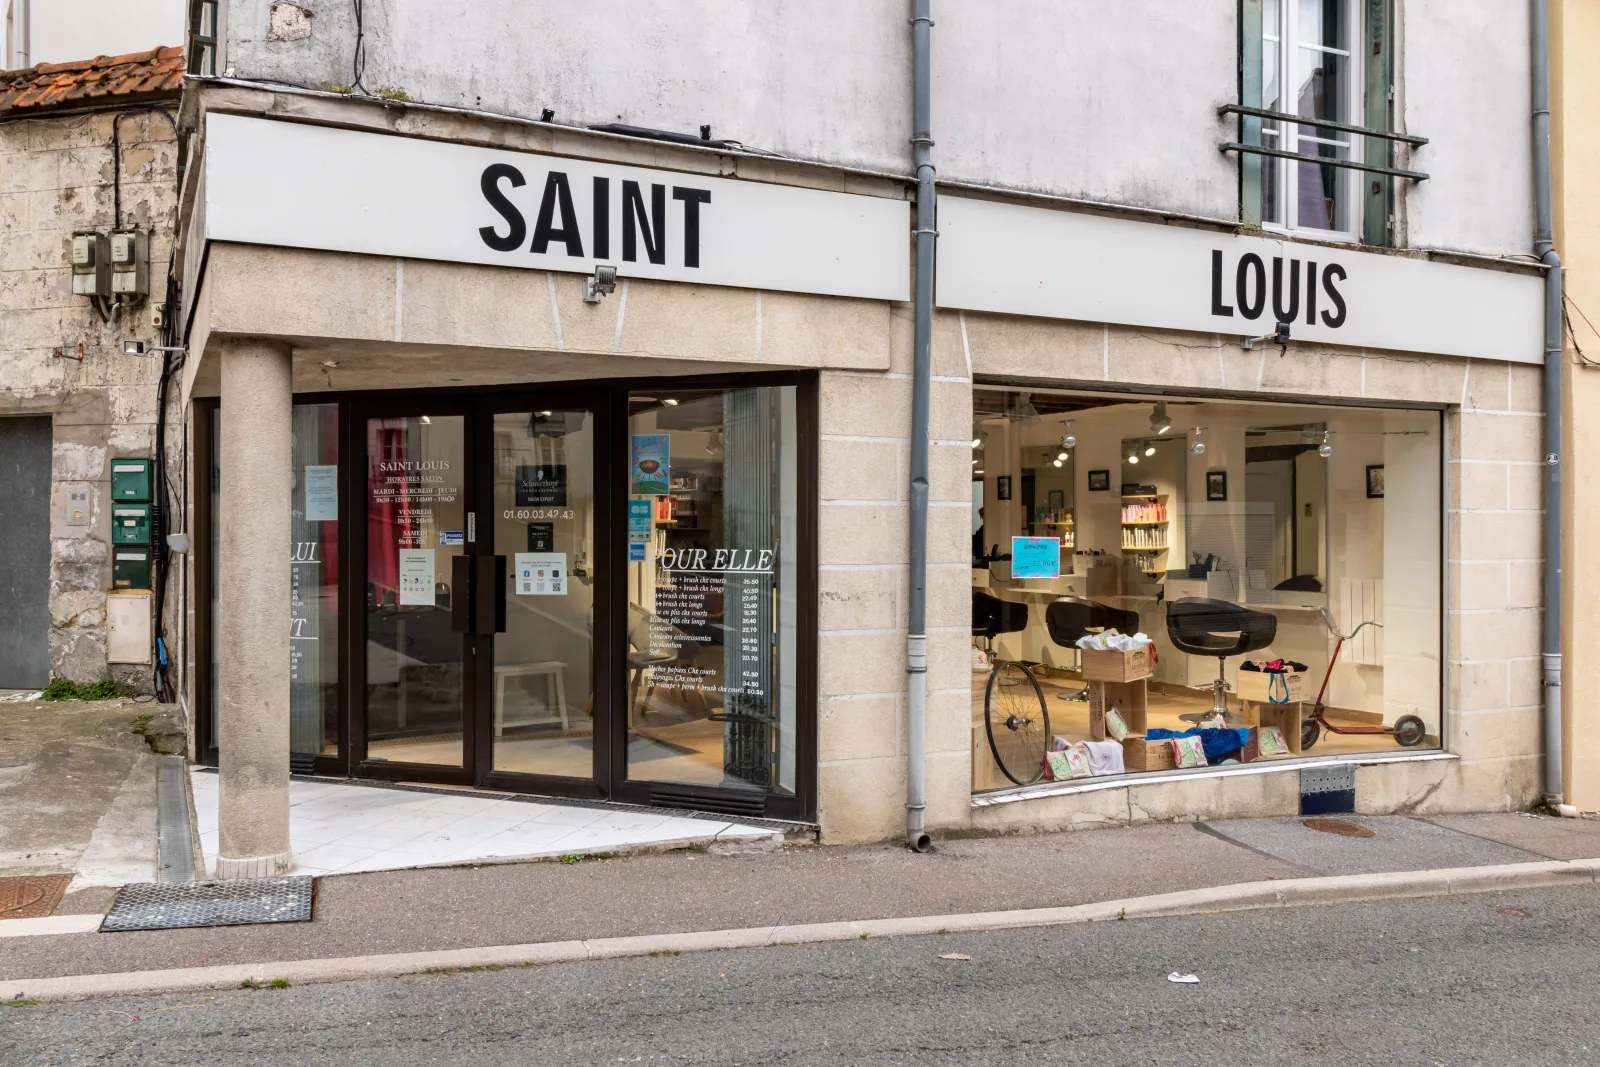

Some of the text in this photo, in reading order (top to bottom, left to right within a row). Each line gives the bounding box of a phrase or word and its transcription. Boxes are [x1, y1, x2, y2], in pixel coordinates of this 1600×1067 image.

[479, 163, 711, 268] SAINT
[1211, 249, 1347, 328] LOUIS
[380, 460, 450, 471] SAINT LOUIS
[522, 479, 559, 488] Schwarzkopf
[437, 487, 457, 495] JEUDI
[503, 509, 574, 519] 01.60.03.42.43
[711, 548, 773, 571] ELLE
[709, 585, 725, 593] longs
[670, 609, 681, 617] plis
[670, 617, 681, 625] plis
[691, 618, 706, 626] longs
[649, 624, 673, 632] Couleurs
[699, 668, 717, 676] courts
[701, 684, 717, 692] brush
